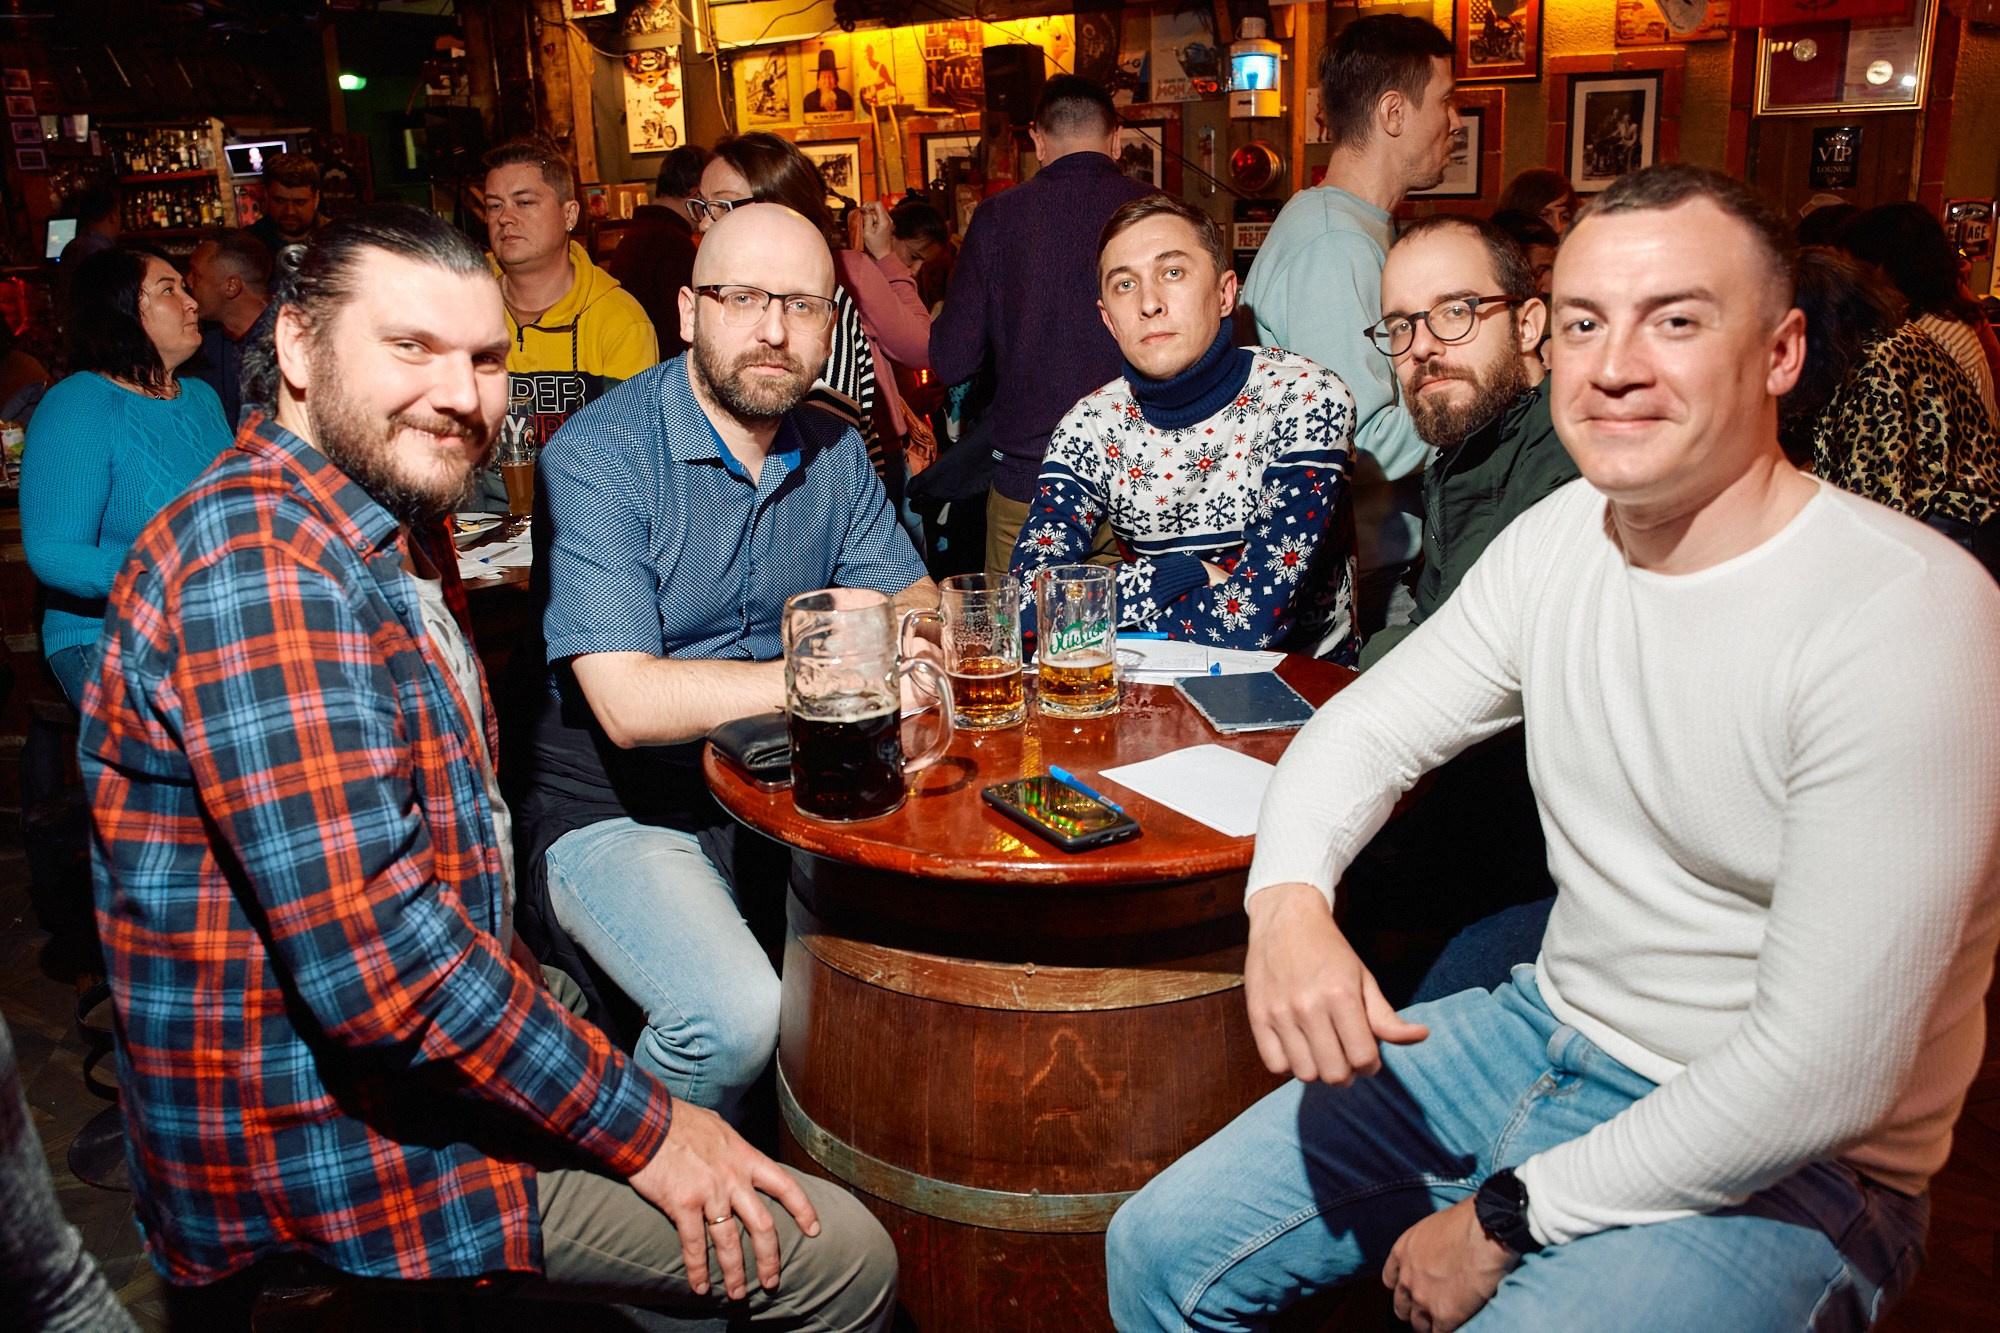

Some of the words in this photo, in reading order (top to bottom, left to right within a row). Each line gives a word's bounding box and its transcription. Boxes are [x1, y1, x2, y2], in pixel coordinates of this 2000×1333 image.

[1819, 146, 1853, 162] VIP
[1817, 165, 1851, 173] LOUNGE
[507, 375, 586, 415] PER
